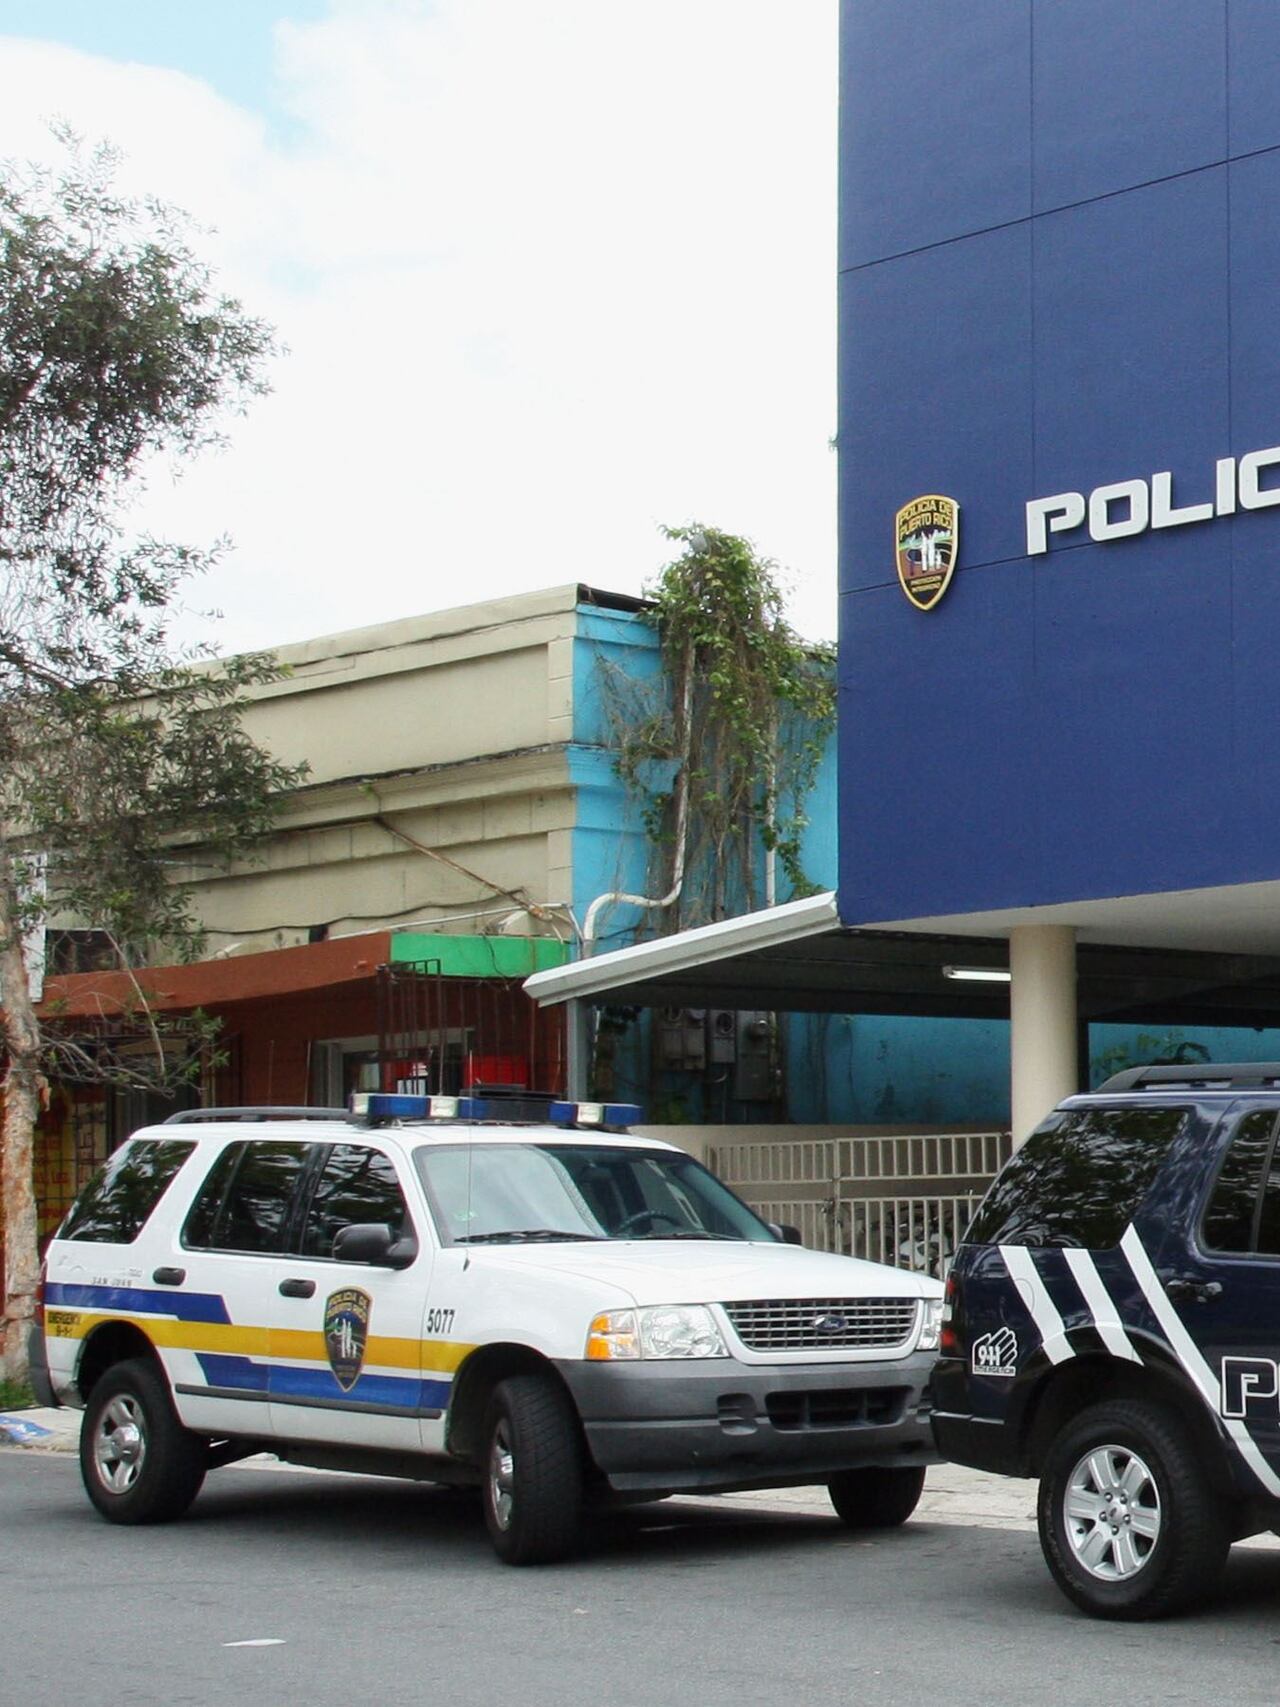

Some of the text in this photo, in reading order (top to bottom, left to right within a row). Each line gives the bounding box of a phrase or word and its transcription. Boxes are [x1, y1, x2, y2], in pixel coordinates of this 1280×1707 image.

[899, 500, 937, 525] POLICIA
[899, 512, 953, 541] PUERTO RICO
[426, 1308, 456, 1334] 5077
